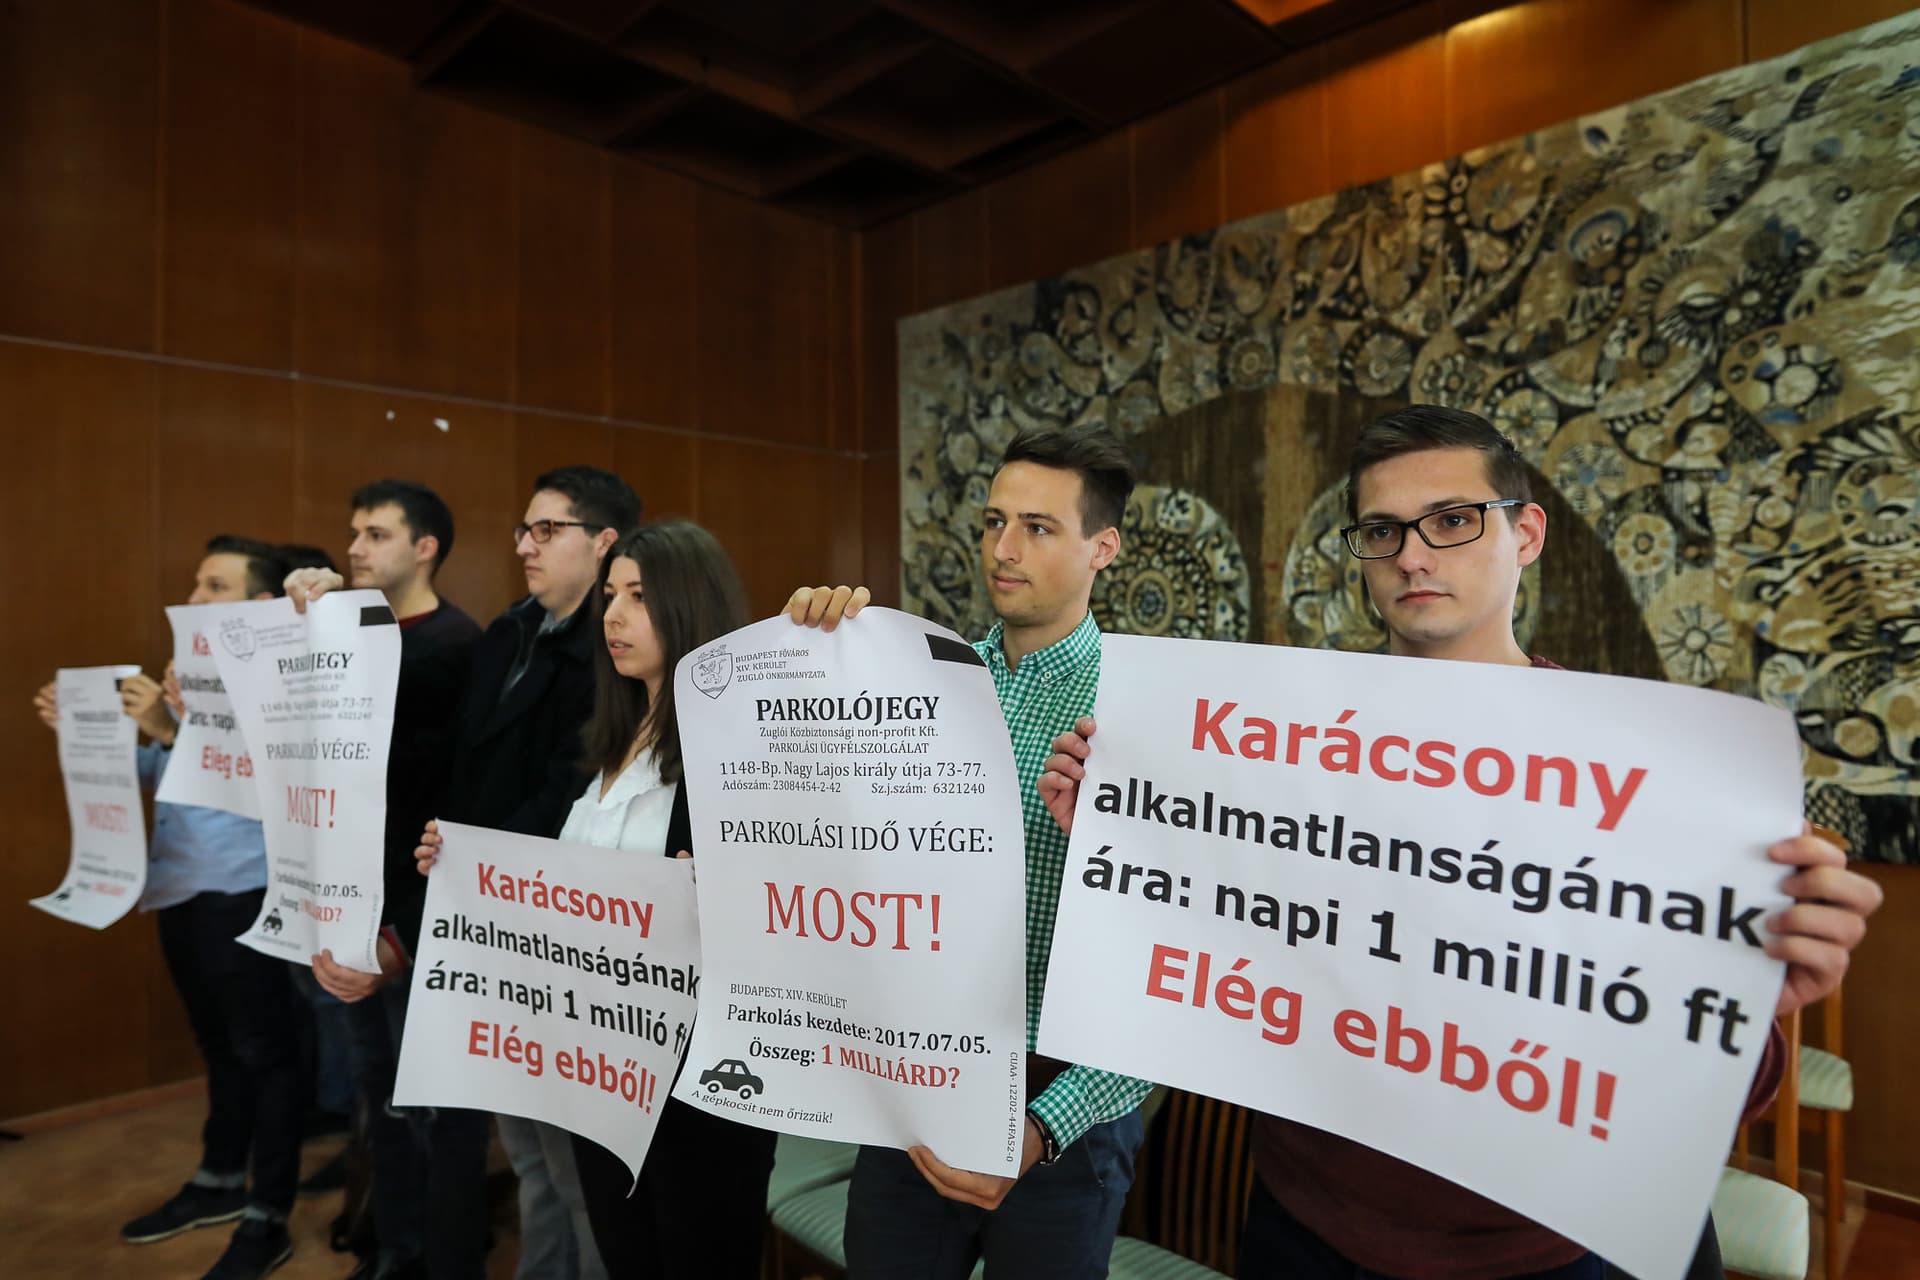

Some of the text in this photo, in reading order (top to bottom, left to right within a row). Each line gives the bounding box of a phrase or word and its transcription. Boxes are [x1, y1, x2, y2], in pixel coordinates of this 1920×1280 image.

[735, 650, 778, 664] BUDAPEST
[736, 671, 764, 683] ZUGLÓ
[755, 690, 940, 727] PARKOLÓJEGY
[759, 725, 939, 740] Zuglói Közbiztonsági non-profit Kft.
[719, 760, 987, 781] 1148-Bp. Nagy Lajos király útja 73-77.
[768, 740, 930, 754] PARKOLÁSI ÜGYFÉLSZOLGÁLAT
[1190, 697, 1648, 832] Karácsony
[722, 779, 985, 797] Adószám: 23084454-2-42 Sz.j.szám: 6321240
[719, 817, 994, 853] PARKOLÁSI IDŐ VÉGE:
[1093, 776, 1766, 949] alkalmatlanságának
[477, 862, 654, 939] Karácsony
[763, 881, 941, 952] MOST!
[431, 913, 701, 1000] alkalmatlanságának
[1080, 844, 1749, 1057] ára: napi 1 millió ft
[425, 960, 488, 996] ára:
[498, 978, 553, 1017] napi
[563, 989, 580, 1021] 1
[589, 1002, 668, 1047] millió
[730, 983, 848, 1010] BUDAPEST, XIV. KERÜLET
[727, 1003, 992, 1055] Parkolás kezdete: 2017.07.05.
[1144, 943, 1619, 1142] Elég ebből!
[467, 1020, 658, 1115] Elég ebből!
[749, 1036, 961, 1089] Összeg: 1 MILLIÁRD?
[691, 1089, 833, 1125] A gépkocsit nem őrizzük!
